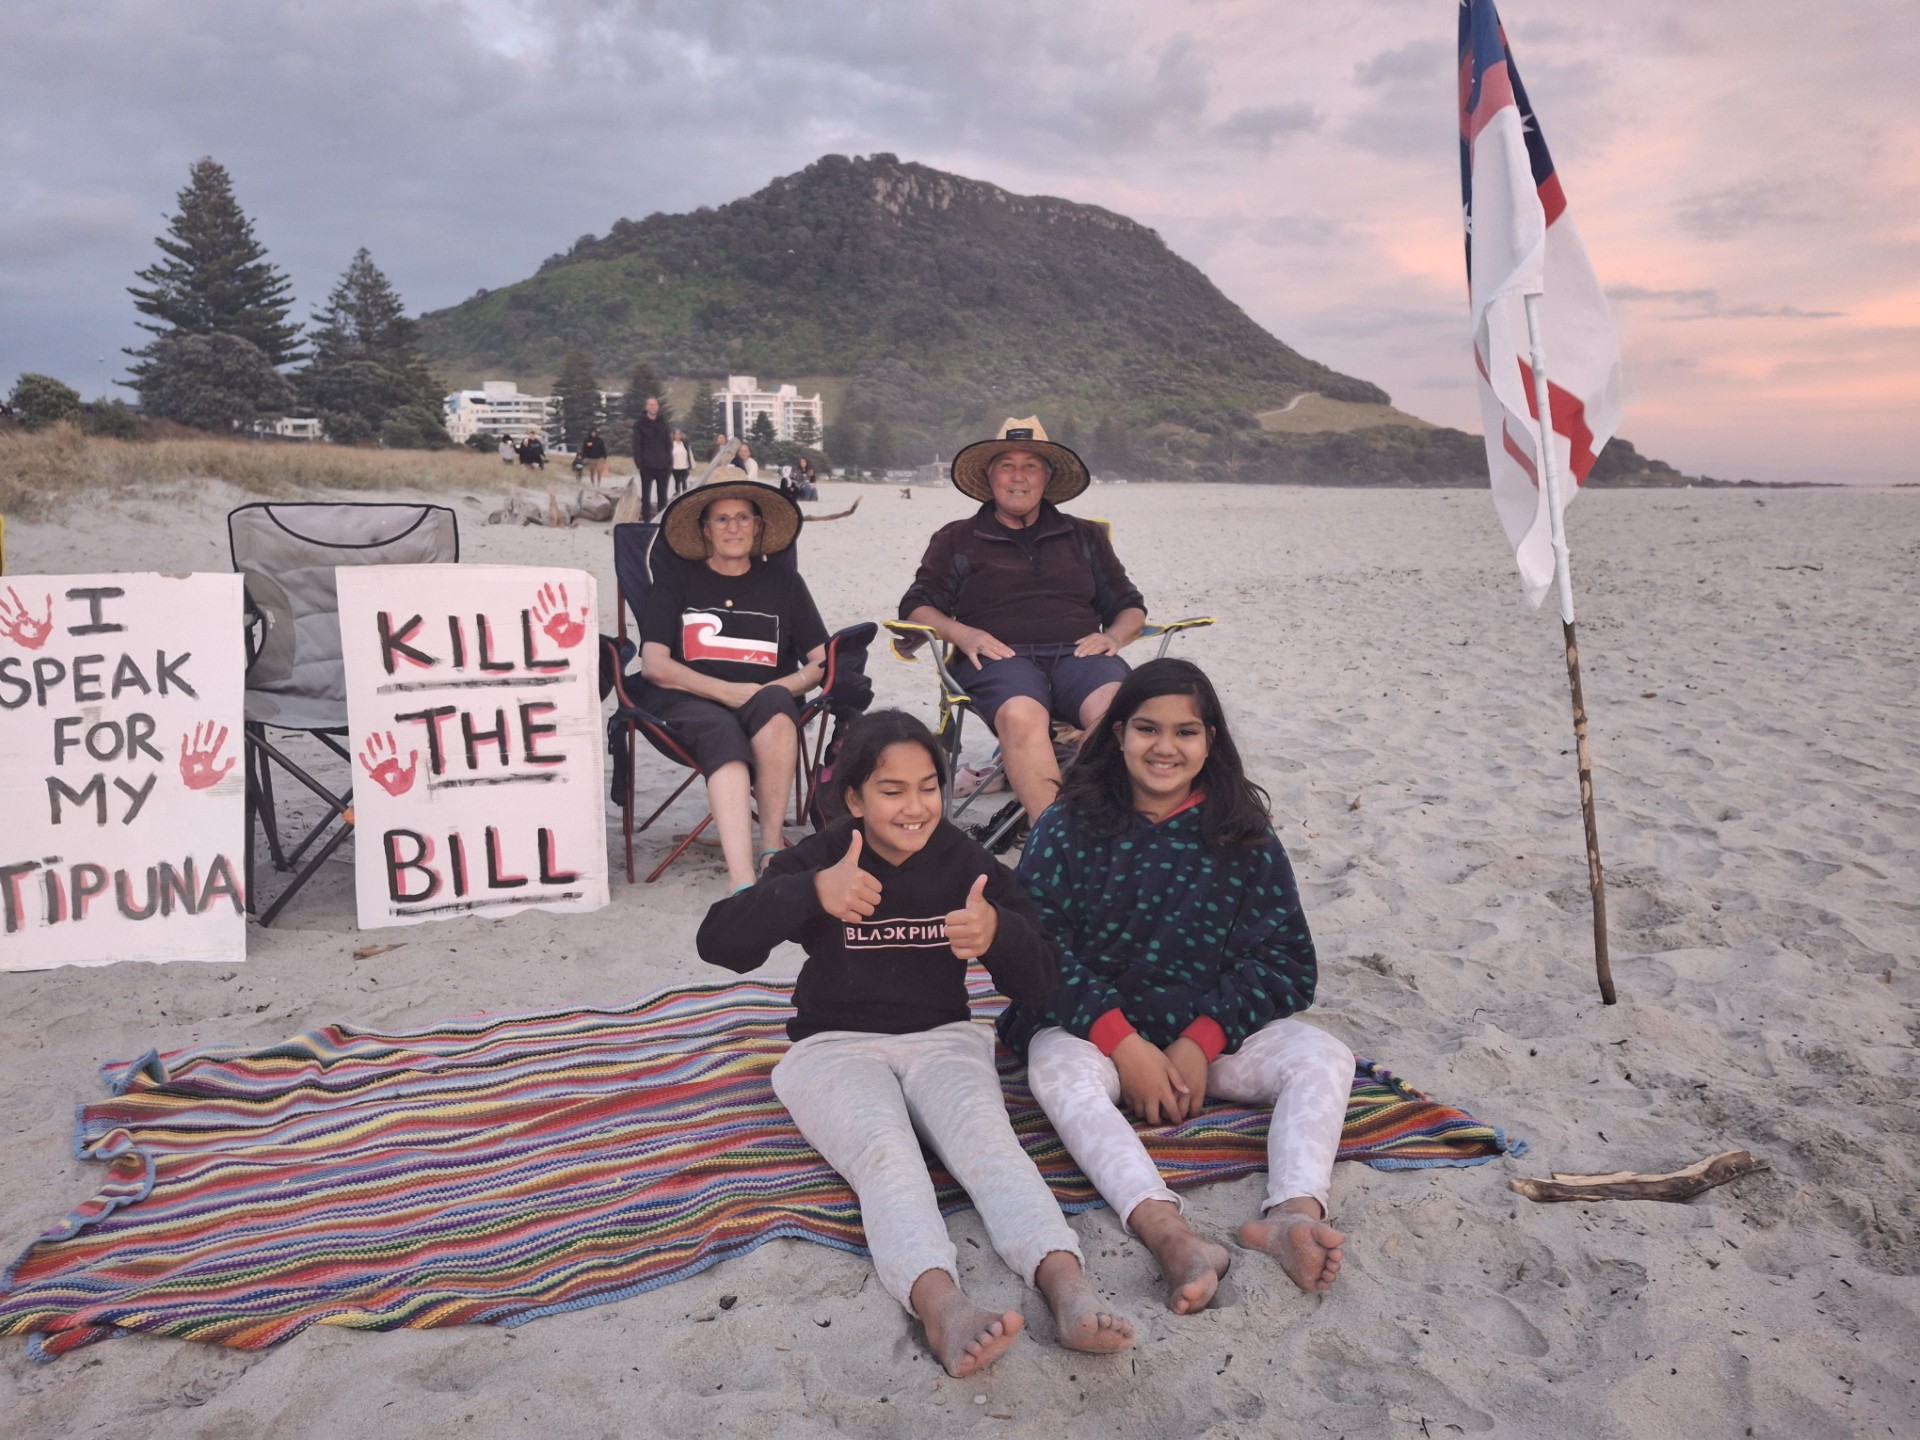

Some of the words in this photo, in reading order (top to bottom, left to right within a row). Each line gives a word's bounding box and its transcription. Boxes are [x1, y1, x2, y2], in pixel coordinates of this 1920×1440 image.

[65, 587, 126, 636] I
[377, 608, 570, 675] KILL
[0, 649, 199, 709] SPEAK
[54, 713, 165, 765] FOR
[395, 699, 567, 776] THE
[45, 773, 158, 826] MY
[383, 826, 582, 903] BILL
